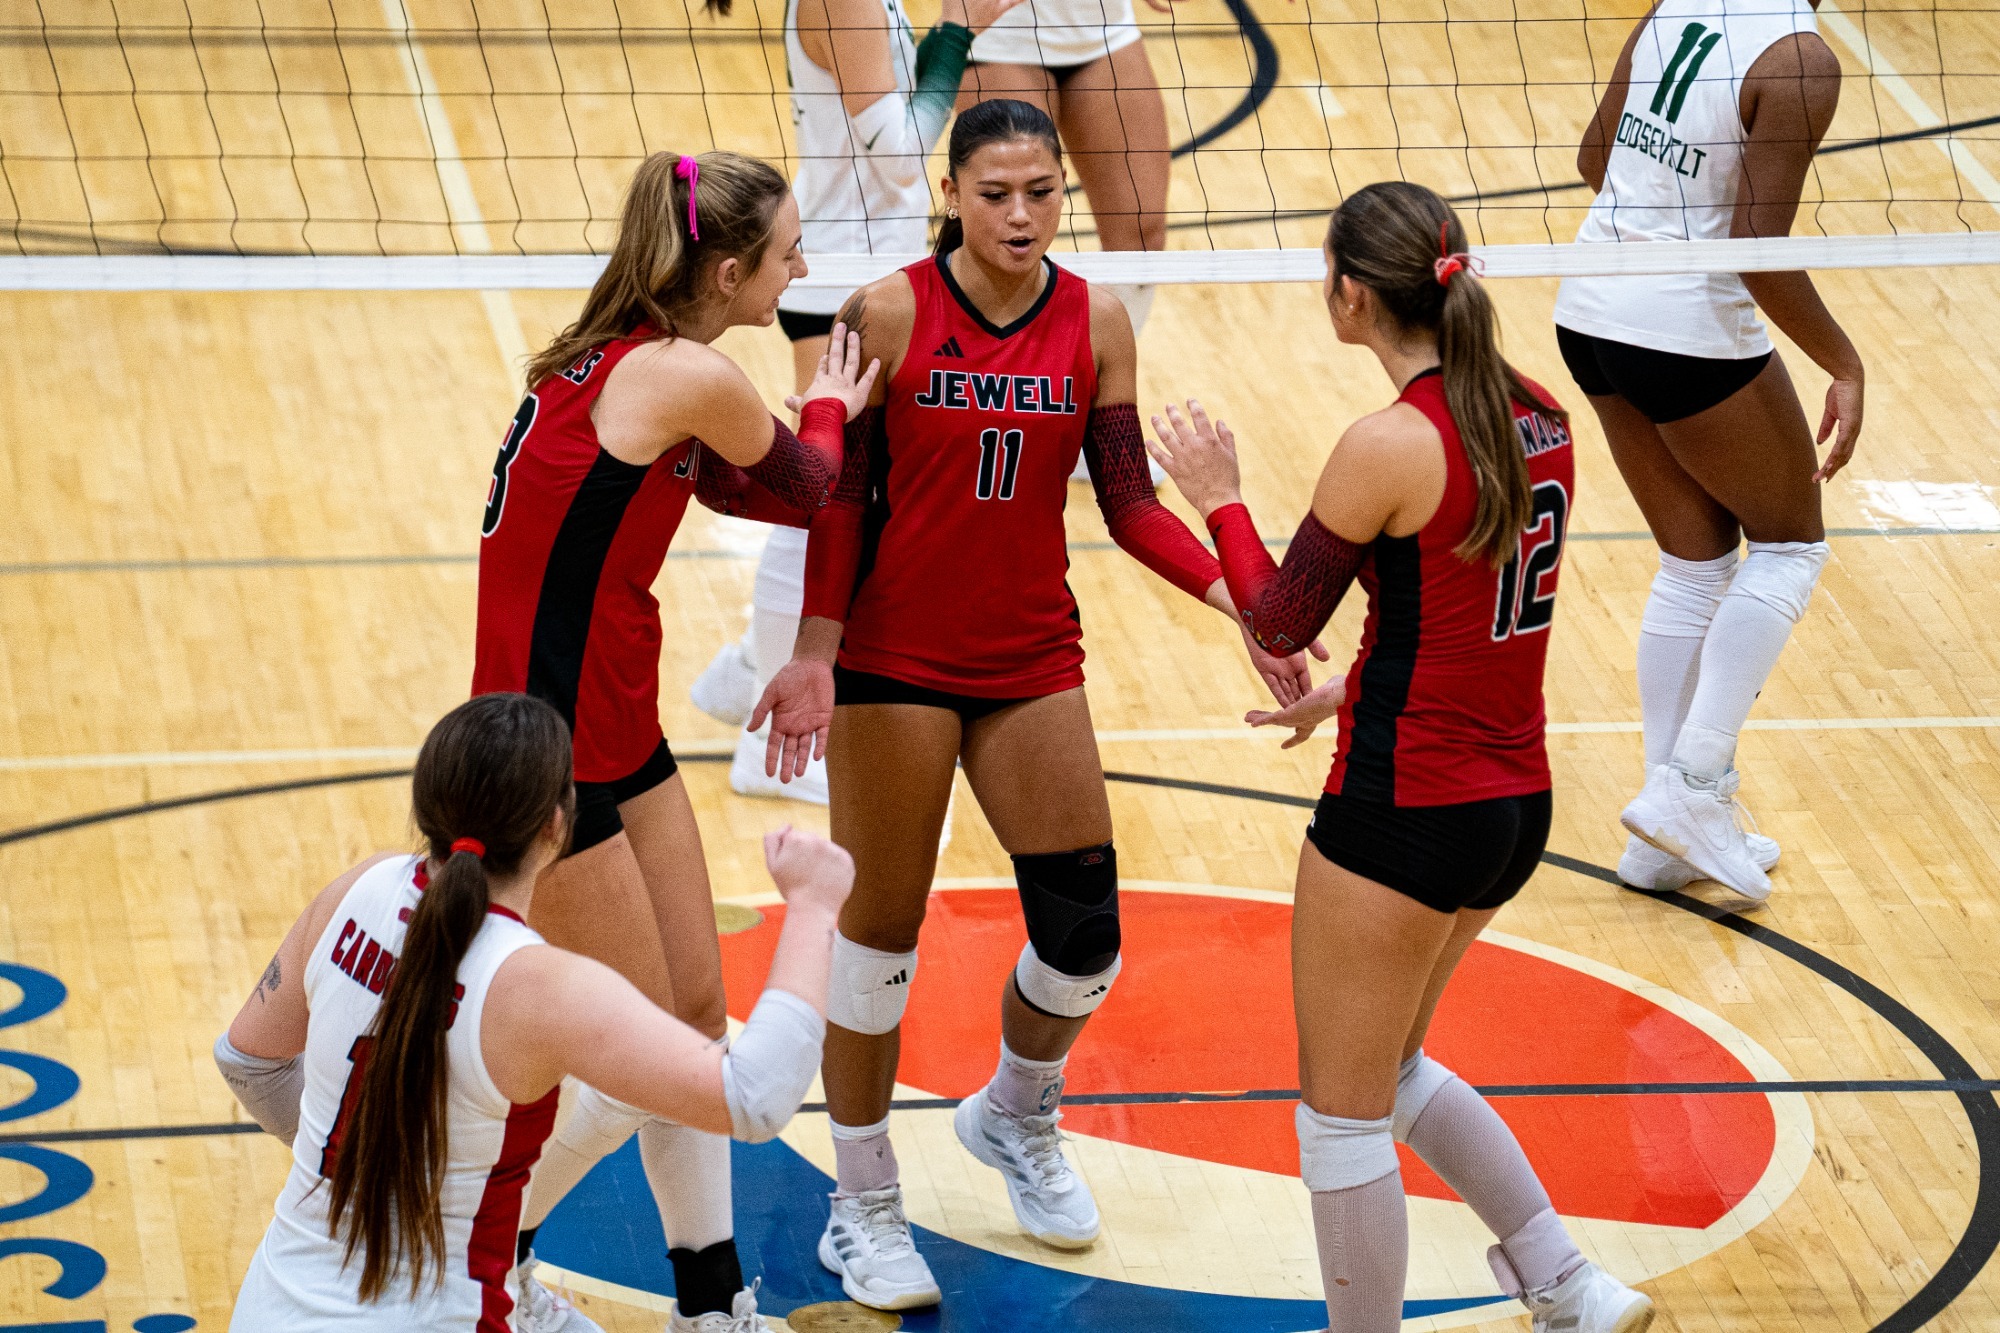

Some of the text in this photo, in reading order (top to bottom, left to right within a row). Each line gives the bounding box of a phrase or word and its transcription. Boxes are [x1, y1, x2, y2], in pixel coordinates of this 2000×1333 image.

[1649, 22, 1723, 125] 11
[915, 369, 1078, 415] JEWELL
[976, 427, 1023, 500] 11
[1491, 479, 1569, 642] 12
